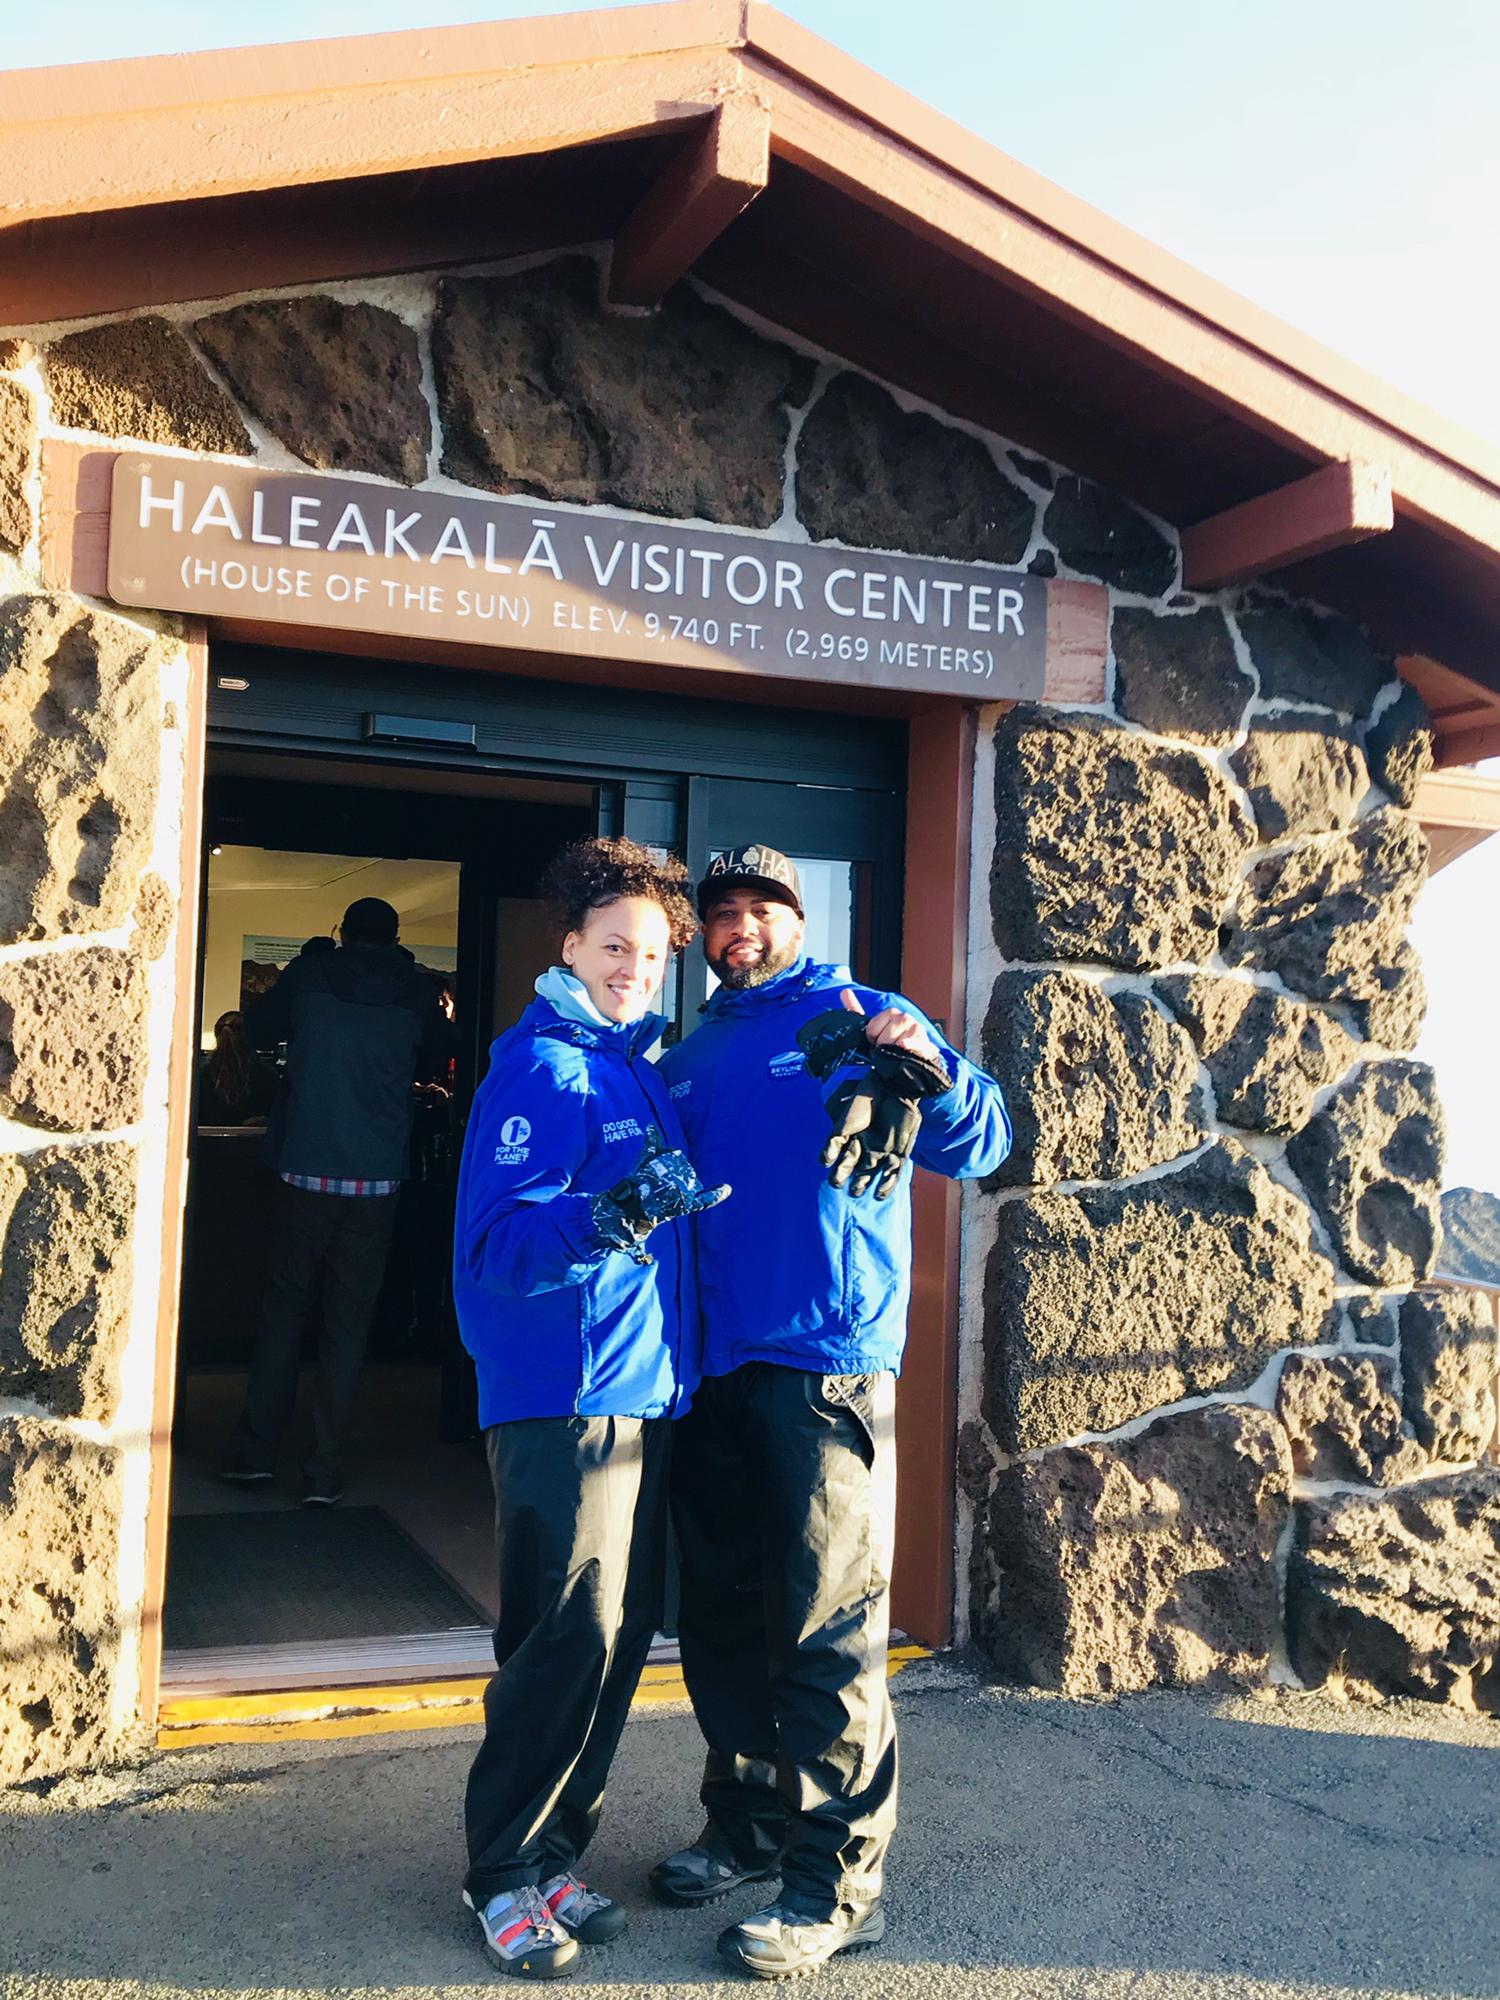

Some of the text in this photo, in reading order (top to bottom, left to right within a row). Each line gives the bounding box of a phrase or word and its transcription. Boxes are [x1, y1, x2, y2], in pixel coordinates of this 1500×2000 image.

[139, 474, 1025, 636] HALEAKALĀ VISITOR CENTER
[180, 555, 994, 679] (HOUSE OF THE SUN) ELEV. 9,740 FT. (2,969 METERS)
[602, 1118, 638, 1133] DO GOOD
[604, 1129, 629, 1144] HAVE
[494, 1153, 529, 1162] PLANET
[495, 1146, 530, 1156] FOR THE
